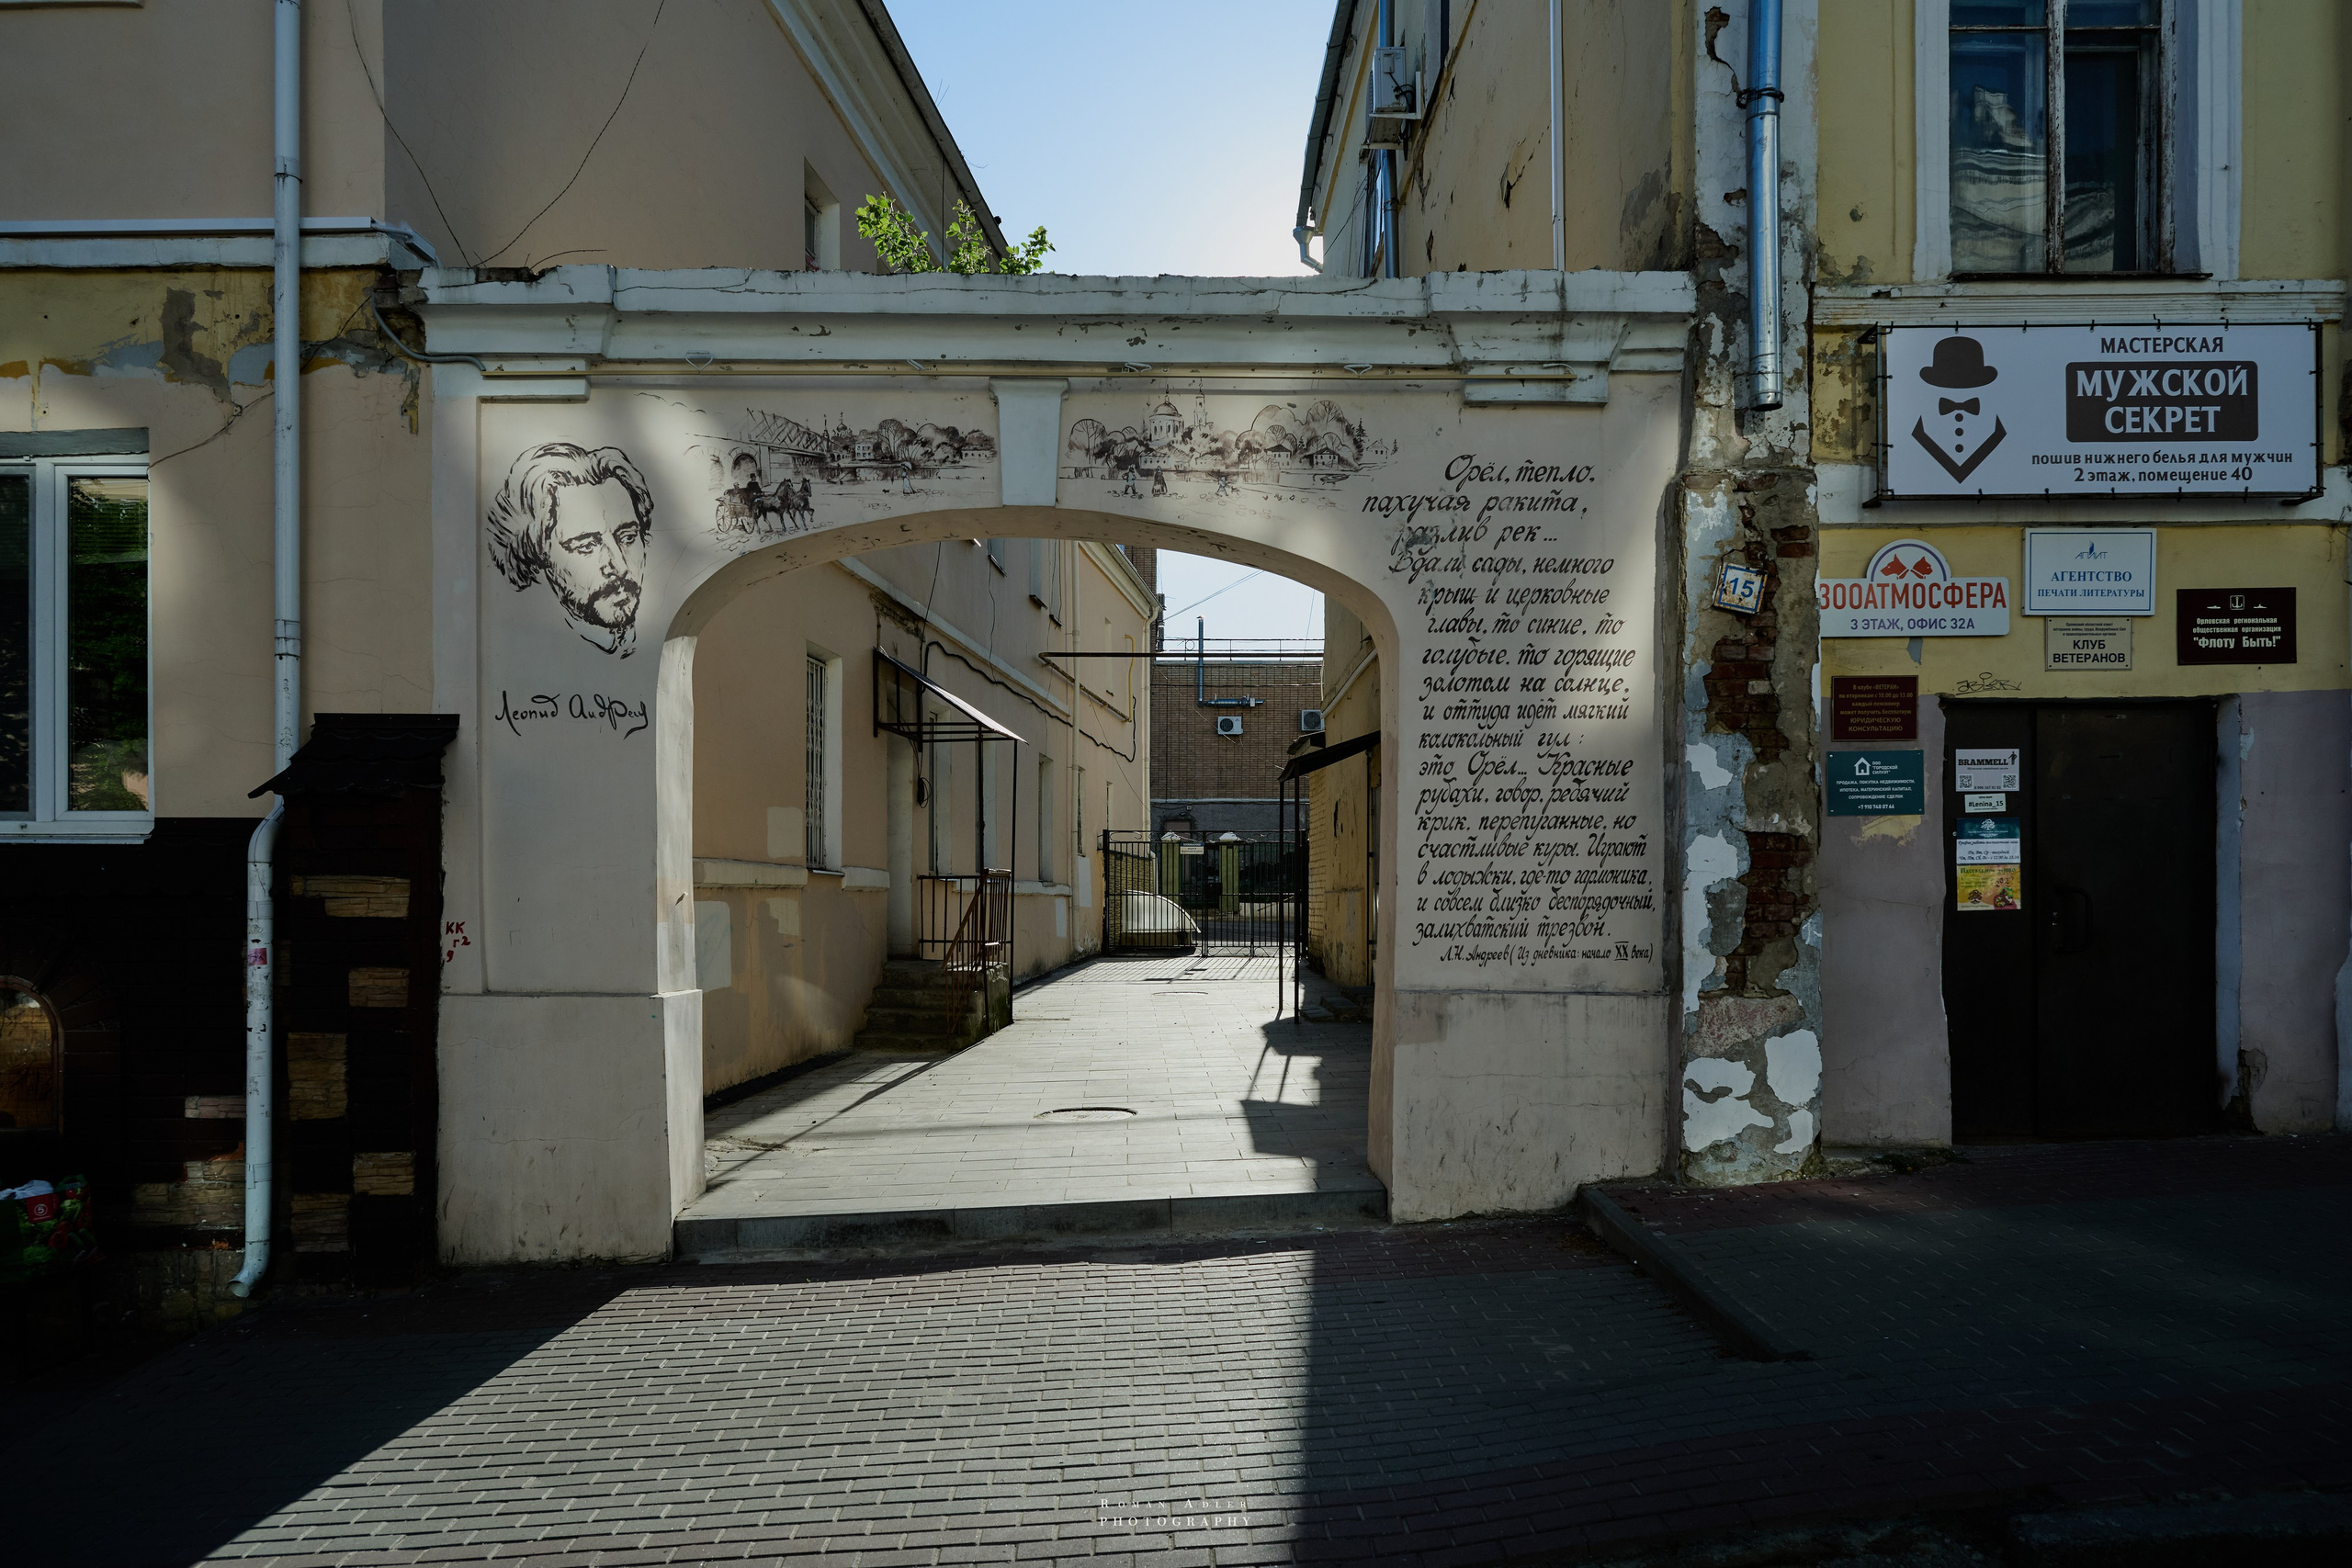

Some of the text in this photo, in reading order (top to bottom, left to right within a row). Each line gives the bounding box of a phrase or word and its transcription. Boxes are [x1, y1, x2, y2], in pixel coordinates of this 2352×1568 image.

[2100, 336, 2224, 354] МАСТЕРСКАЯ
[2075, 366, 2248, 401] МУЖСКОЙ
[2104, 406, 2222, 434] СЕКРЕТ
[2031, 451, 2293, 466] пошив нижнего белья для мужчин
[1444, 454, 1596, 491] Орёл, тепло,
[2075, 467, 2253, 483] 2 этаж, помещение 40
[1363, 492, 1471, 523] пахучая
[1391, 516, 1489, 555] разлив
[1388, 547, 1615, 585] Вдали сады, немного
[2051, 570, 2132, 582] АГЕНТСТВО
[1418, 577, 1611, 616] крыш и церковные
[1729, 577, 1755, 598] 15
[1820, 582, 2007, 610] ЗООАТМОСФЕРА
[2038, 588, 2145, 598] ПЕЧАТИ ЛИТЕРАТУРЫ
[1427, 605, 1626, 637] главы, то синие, то
[1850, 617, 1975, 632] 3 ЭТАЖ, ОФИС 32А
[2192, 626, 2239, 634] общественная
[2196, 617, 2231, 626] Орловская
[2073, 639, 2106, 649] КЛУБ
[2193, 636, 2281, 649] "Флоту Быть!"
[1517, 642, 1551, 666] то
[1553, 649, 1636, 677] горящие
[2053, 653, 2125, 663] ВЕТЕРАНОВ
[1419, 675, 1630, 702] золотом на солнце,
[1422, 696, 1631, 730] и оттуда идёт мягкий
[1419, 728, 1523, 749] колокольный
[1419, 753, 1454, 776] это
[1537, 750, 1634, 784] Красные
[1958, 758, 2008, 766] BRAMMELL
[1415, 776, 1632, 815] рубахи, говор, ребячий
[1968, 800, 2004, 808] #Lenina_15
[1478, 814, 1607, 842] перепуганные,
[1612, 814, 1638, 830] но
[1418, 832, 1649, 869] счастливые куры. Играют
[1417, 860, 1652, 894] в лодыжки, где-то гармоника,
[1417, 886, 1656, 920] и совсем близко беспорядочный,
[1412, 915, 1611, 948] залихватский трезвон.
[1581, 948, 1611, 960] начало
[1631, 942, 1654, 964] века)
[38, 1206, 44, 1214] 5
